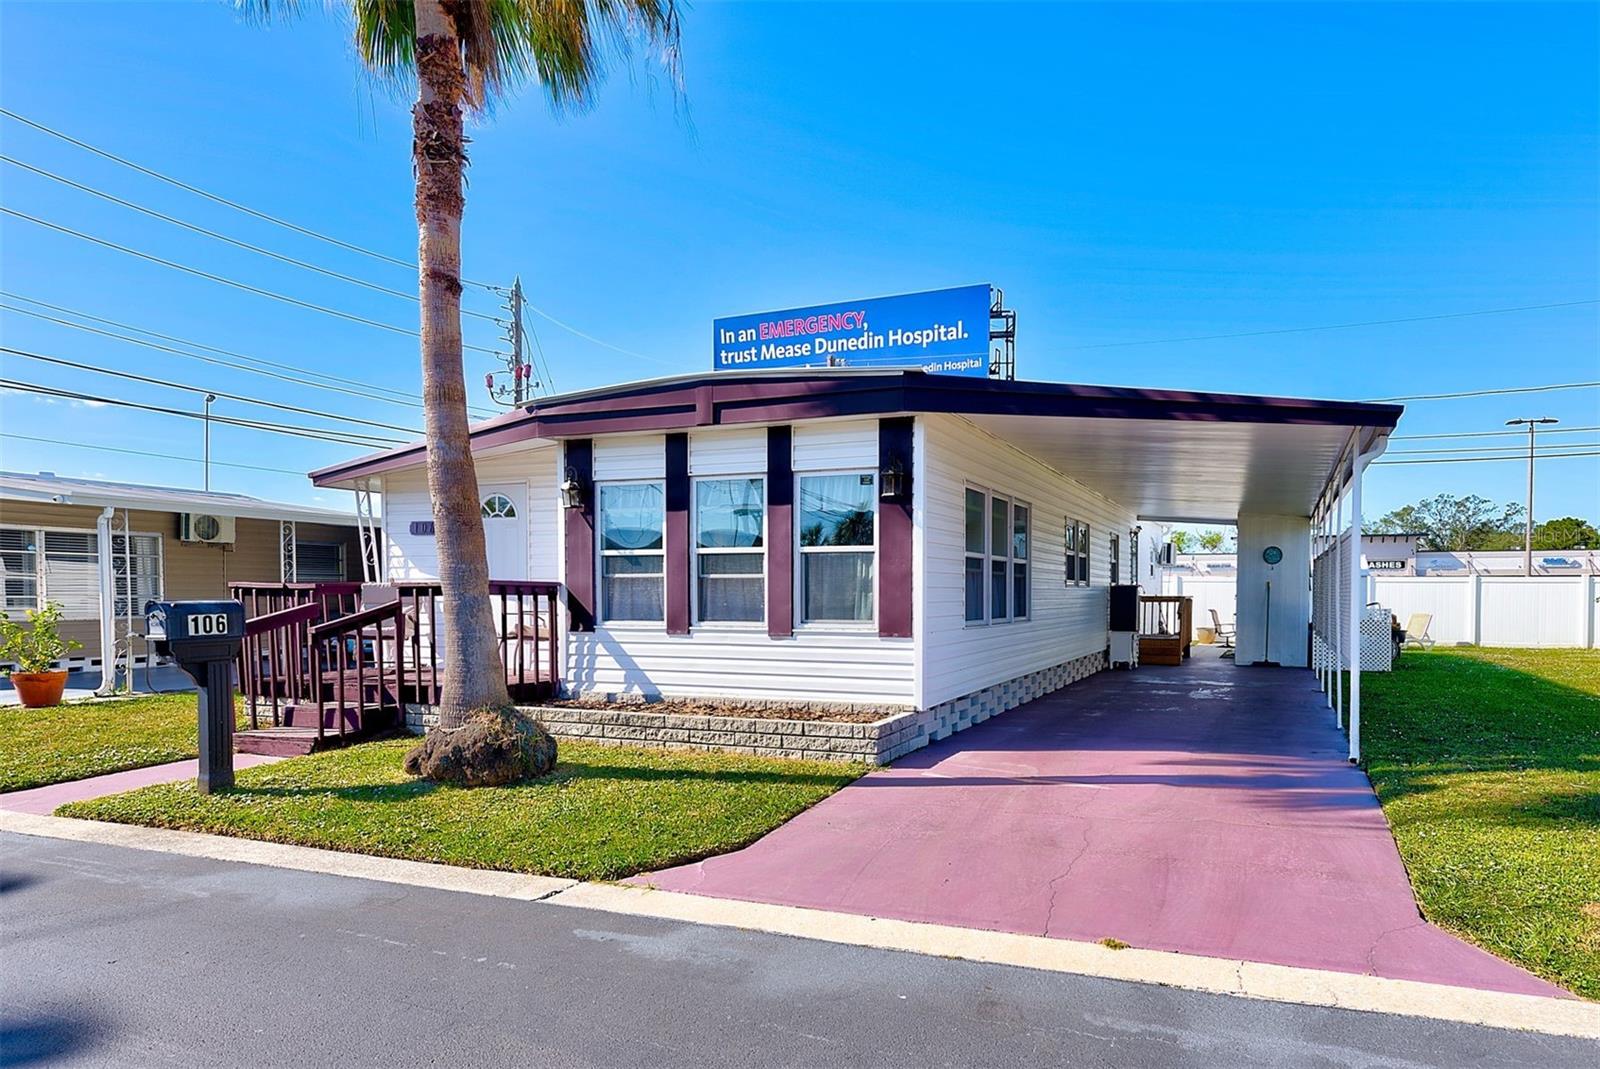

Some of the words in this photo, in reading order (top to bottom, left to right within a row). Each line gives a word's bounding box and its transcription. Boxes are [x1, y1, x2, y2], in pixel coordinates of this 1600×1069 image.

[720, 329, 735, 344] In
[738, 329, 756, 341] an
[759, 311, 868, 340] EMERGENCY,
[720, 346, 758, 364] trust
[760, 343, 811, 360] Mease
[815, 331, 883, 354] Dunedin
[889, 320, 969, 348] Hospital.
[944, 357, 982, 371] Hospital
[191, 615, 226, 634] 106
